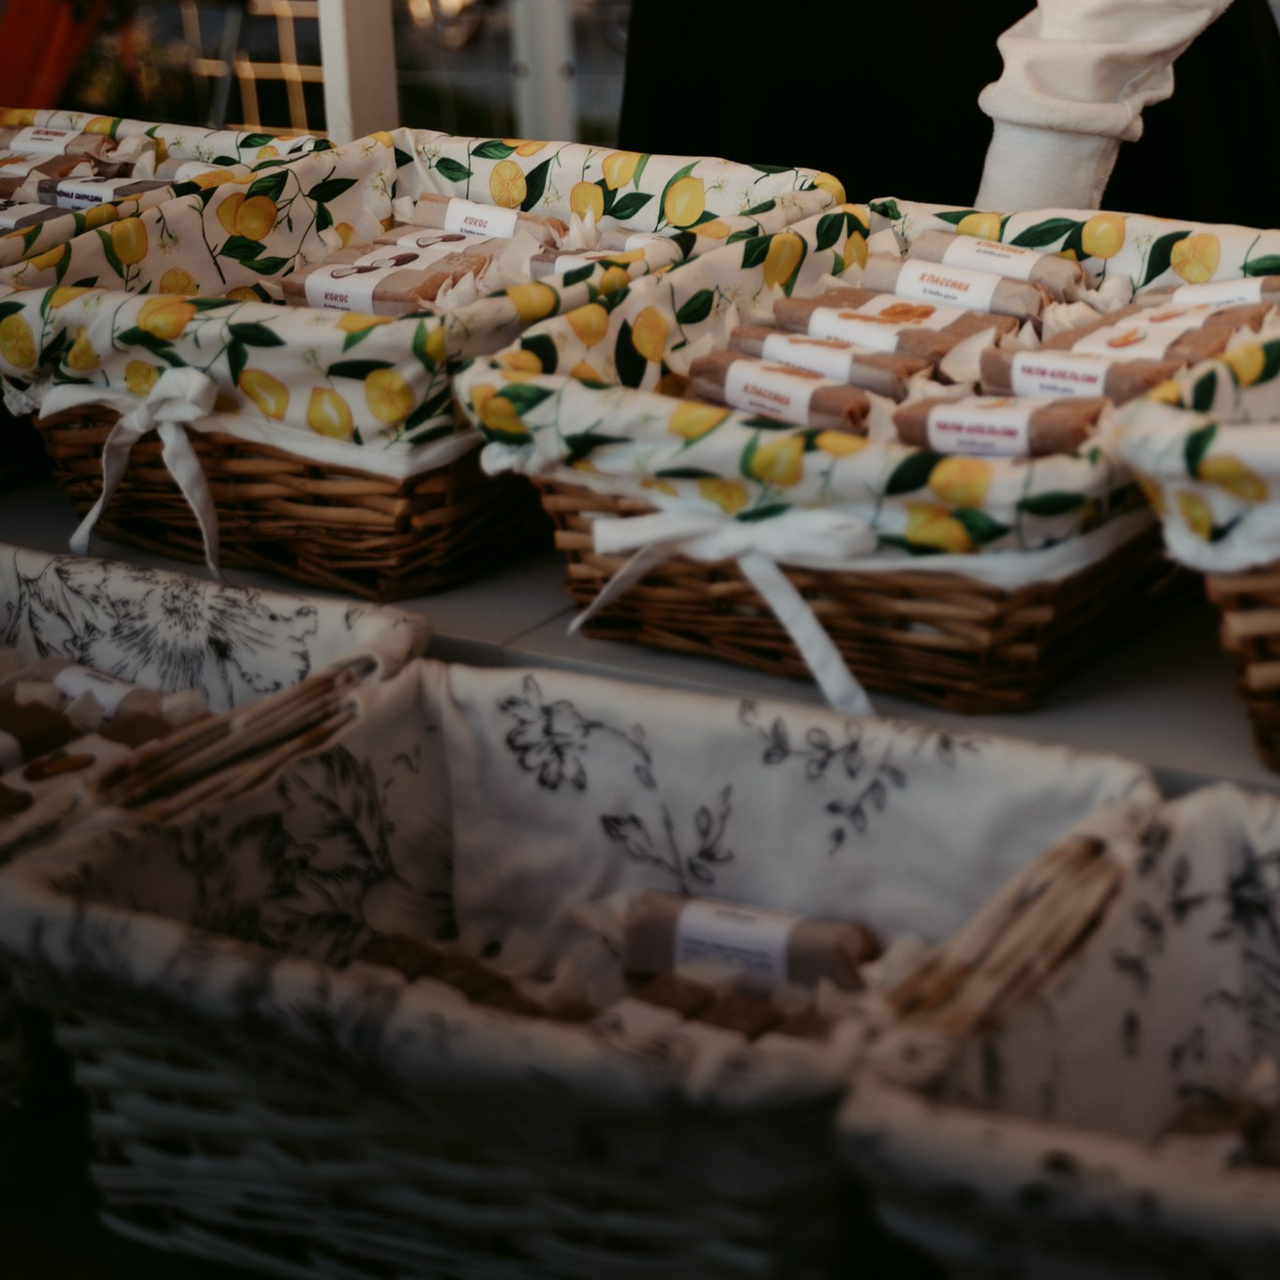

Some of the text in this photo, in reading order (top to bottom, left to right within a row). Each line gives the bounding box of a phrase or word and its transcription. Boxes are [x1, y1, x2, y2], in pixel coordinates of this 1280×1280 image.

[463, 215, 488, 229] КОКОС
[918, 272, 970, 292] КЛАССИКА
[323, 291, 349, 303] КОКОС
